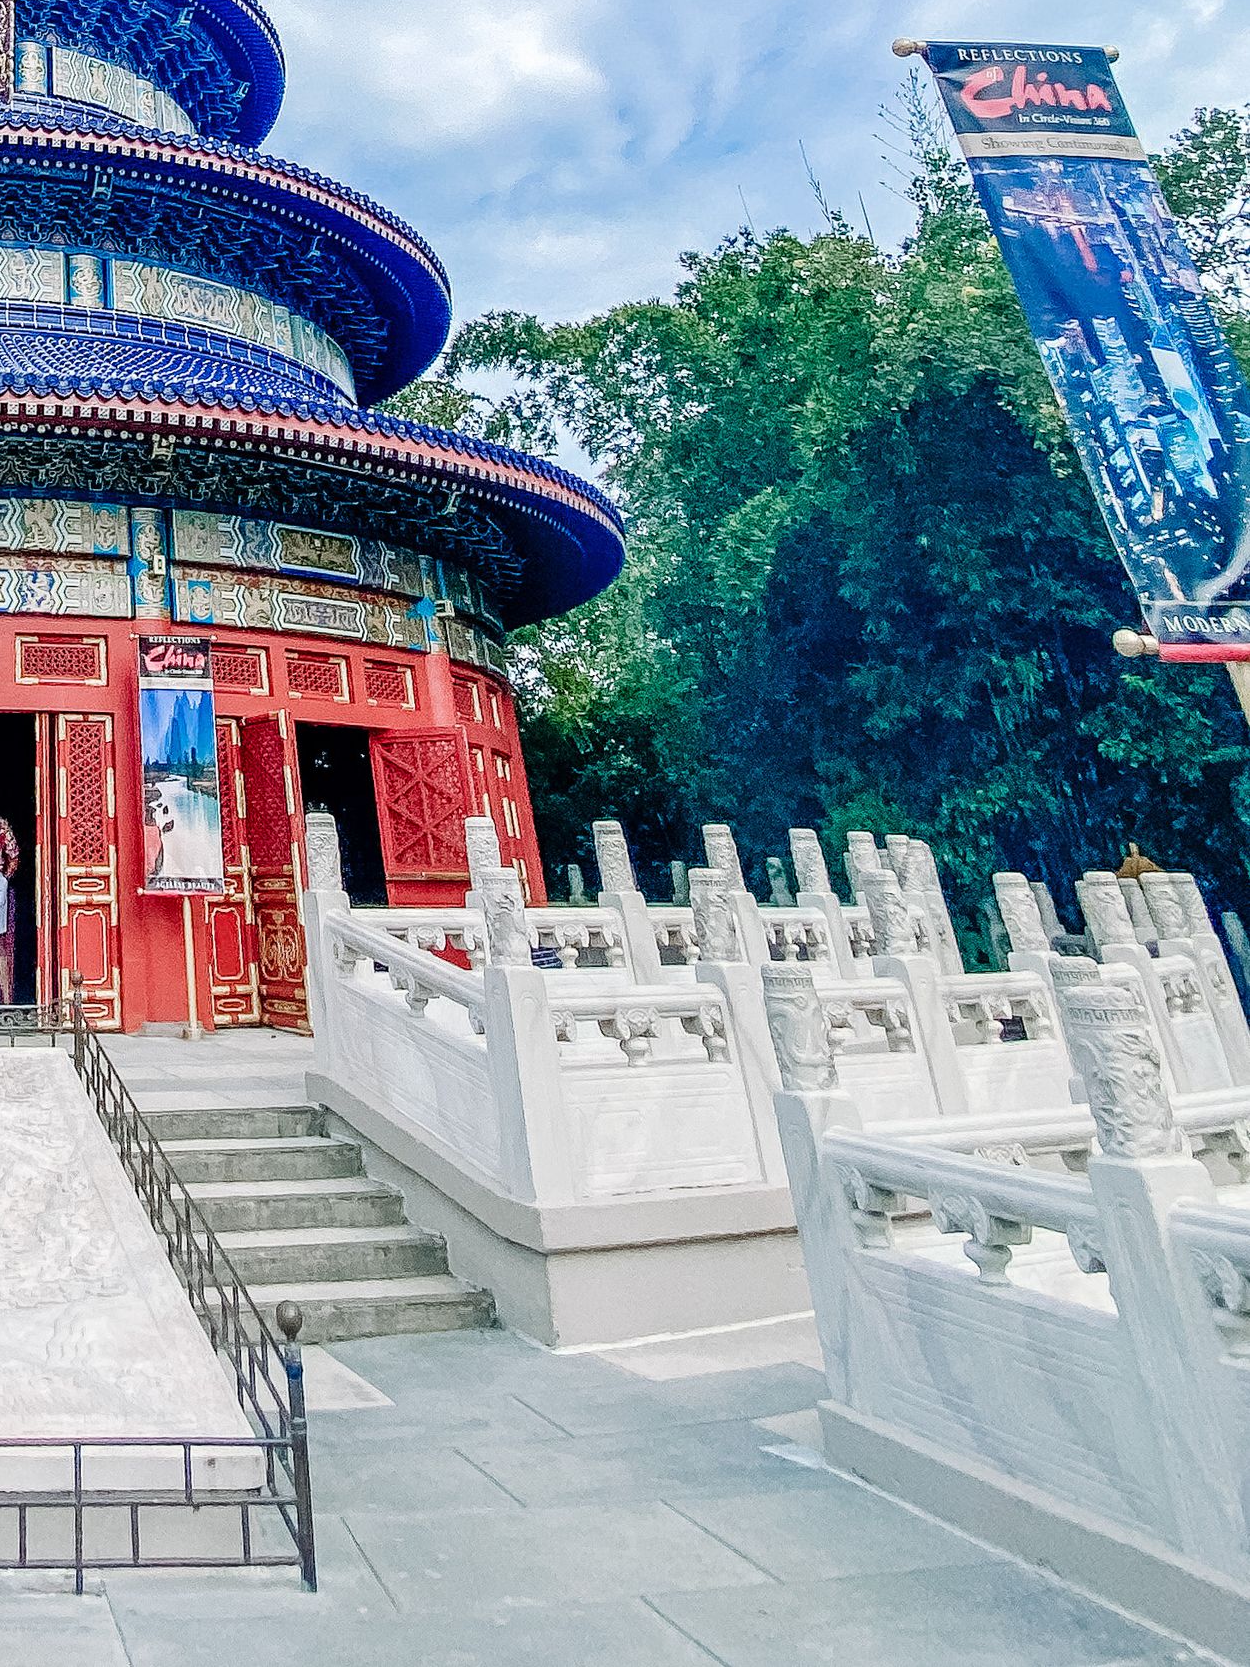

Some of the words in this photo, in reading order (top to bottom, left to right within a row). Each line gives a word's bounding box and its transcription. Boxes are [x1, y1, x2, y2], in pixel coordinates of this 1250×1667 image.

[957, 48, 1083, 64] REFLECTIONS
[960, 65, 1112, 118] China
[981, 137, 1044, 150] Showing
[1162, 615, 1250, 633] MODERN
[149, 636, 201, 644] REFLECTIONS
[141, 645, 205, 671] China
